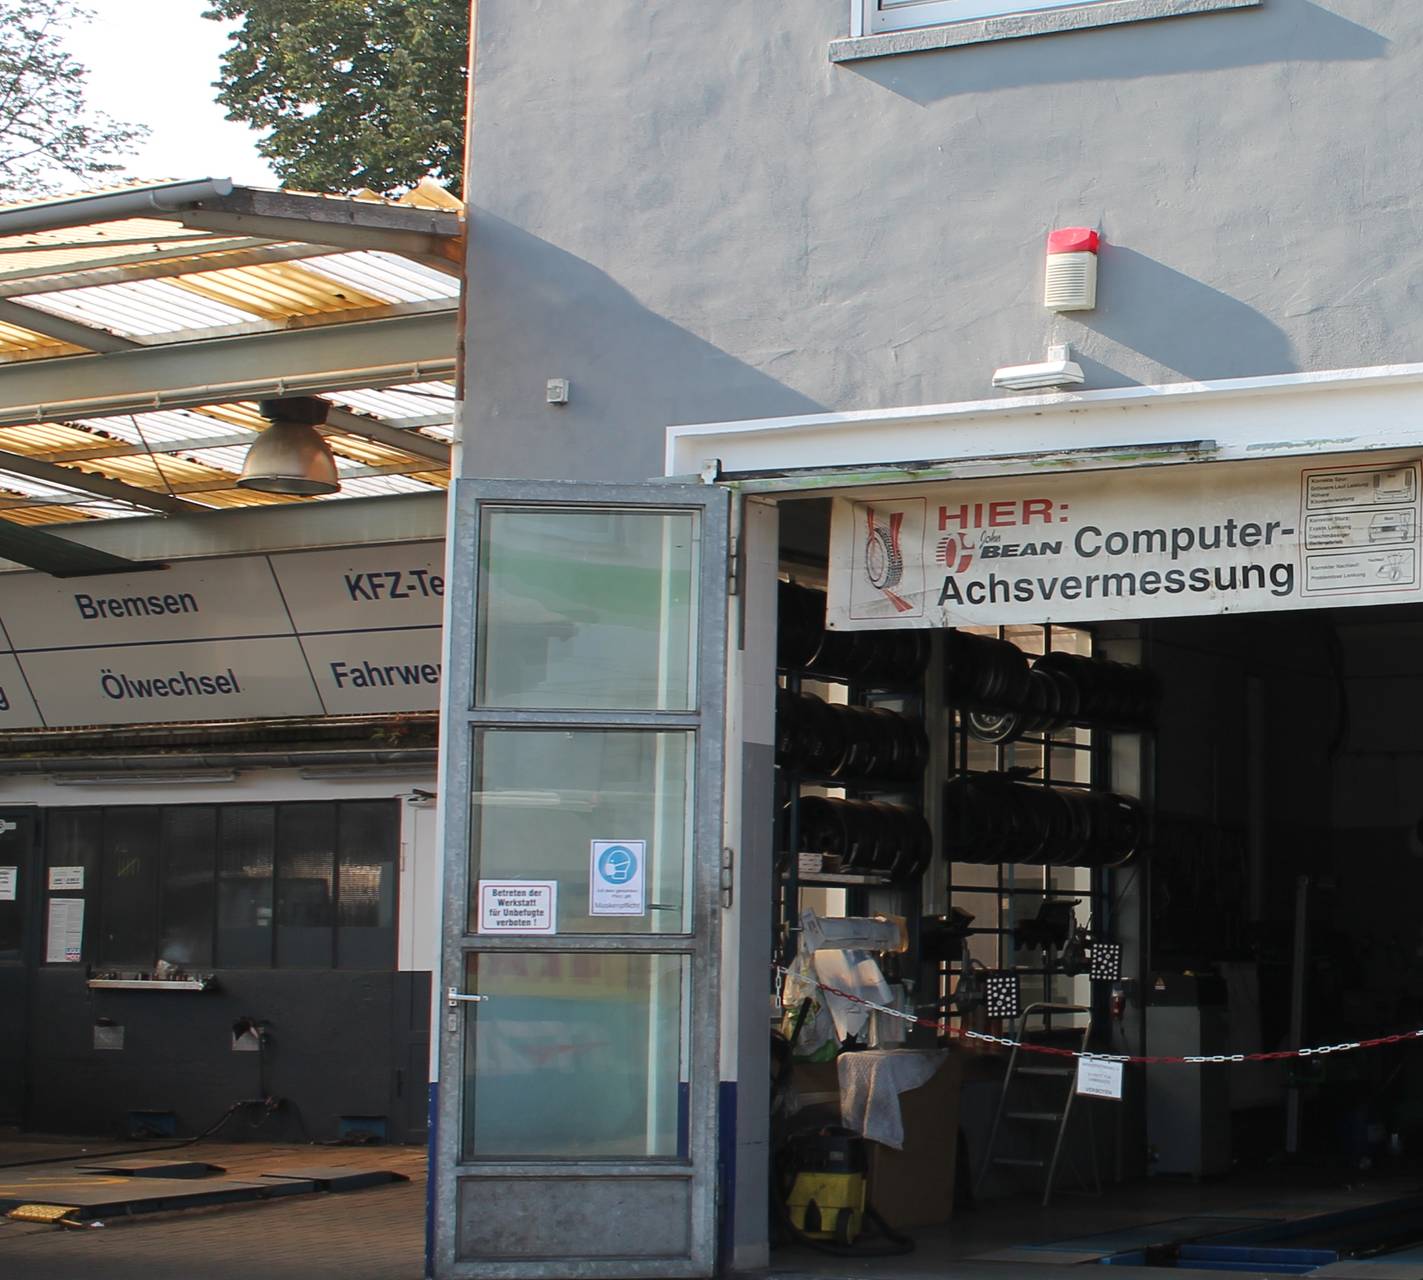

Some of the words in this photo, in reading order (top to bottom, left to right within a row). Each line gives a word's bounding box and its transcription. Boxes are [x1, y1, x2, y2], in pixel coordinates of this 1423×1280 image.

[938, 498, 1068, 530] HIER:
[980, 541, 1063, 559] BEAN
[1074, 518, 1295, 558] Computer-
[938, 561, 1295, 606] Achsvermessung
[74, 592, 198, 620] Bremsen
[100, 668, 240, 700] Ölwechsel
[503, 909, 544, 918] Unbefugte
